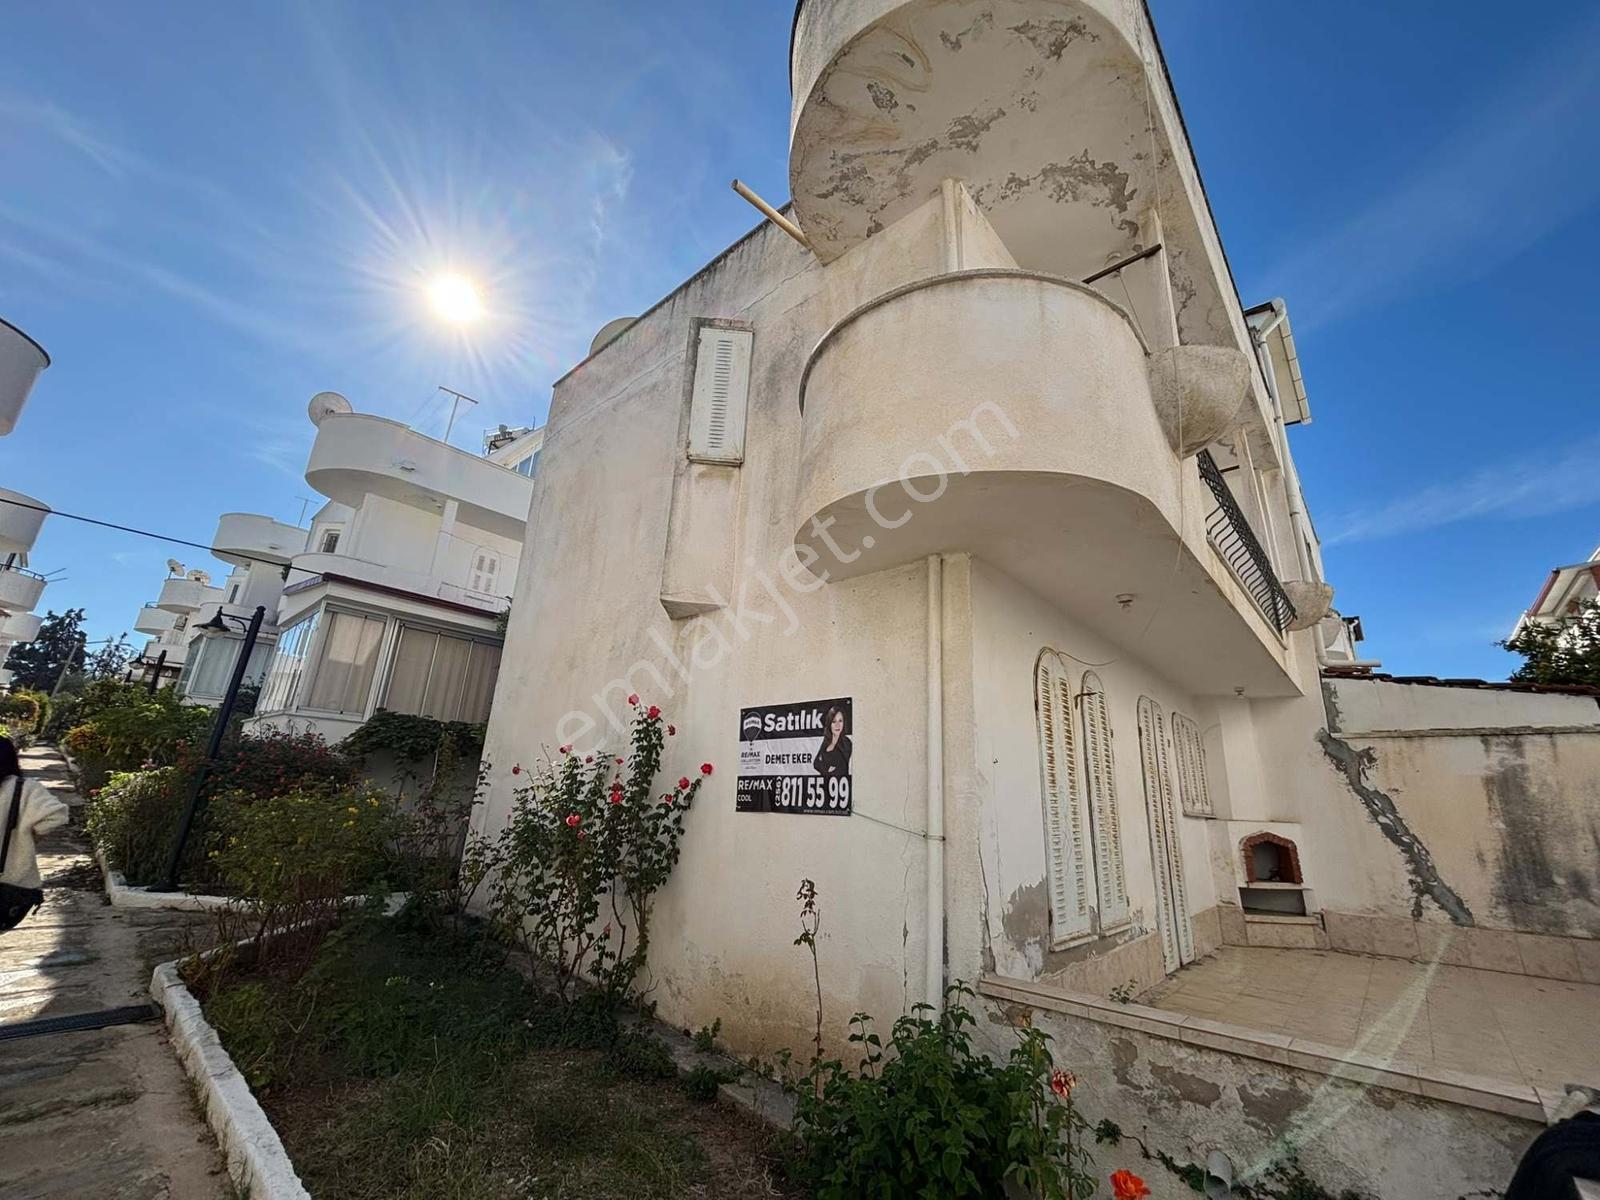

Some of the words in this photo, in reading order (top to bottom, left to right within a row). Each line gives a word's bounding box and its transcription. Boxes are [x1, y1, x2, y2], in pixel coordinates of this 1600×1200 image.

[764, 709, 824, 732] Satılık
[765, 754, 790, 765] DEMET
[791, 753, 812, 764] EKER
[738, 779, 773, 791] RE/MAX
[737, 794, 752, 802] COOL
[781, 776, 803, 807] 811
[806, 777, 825, 808] 55
[828, 776, 850, 809] 99
